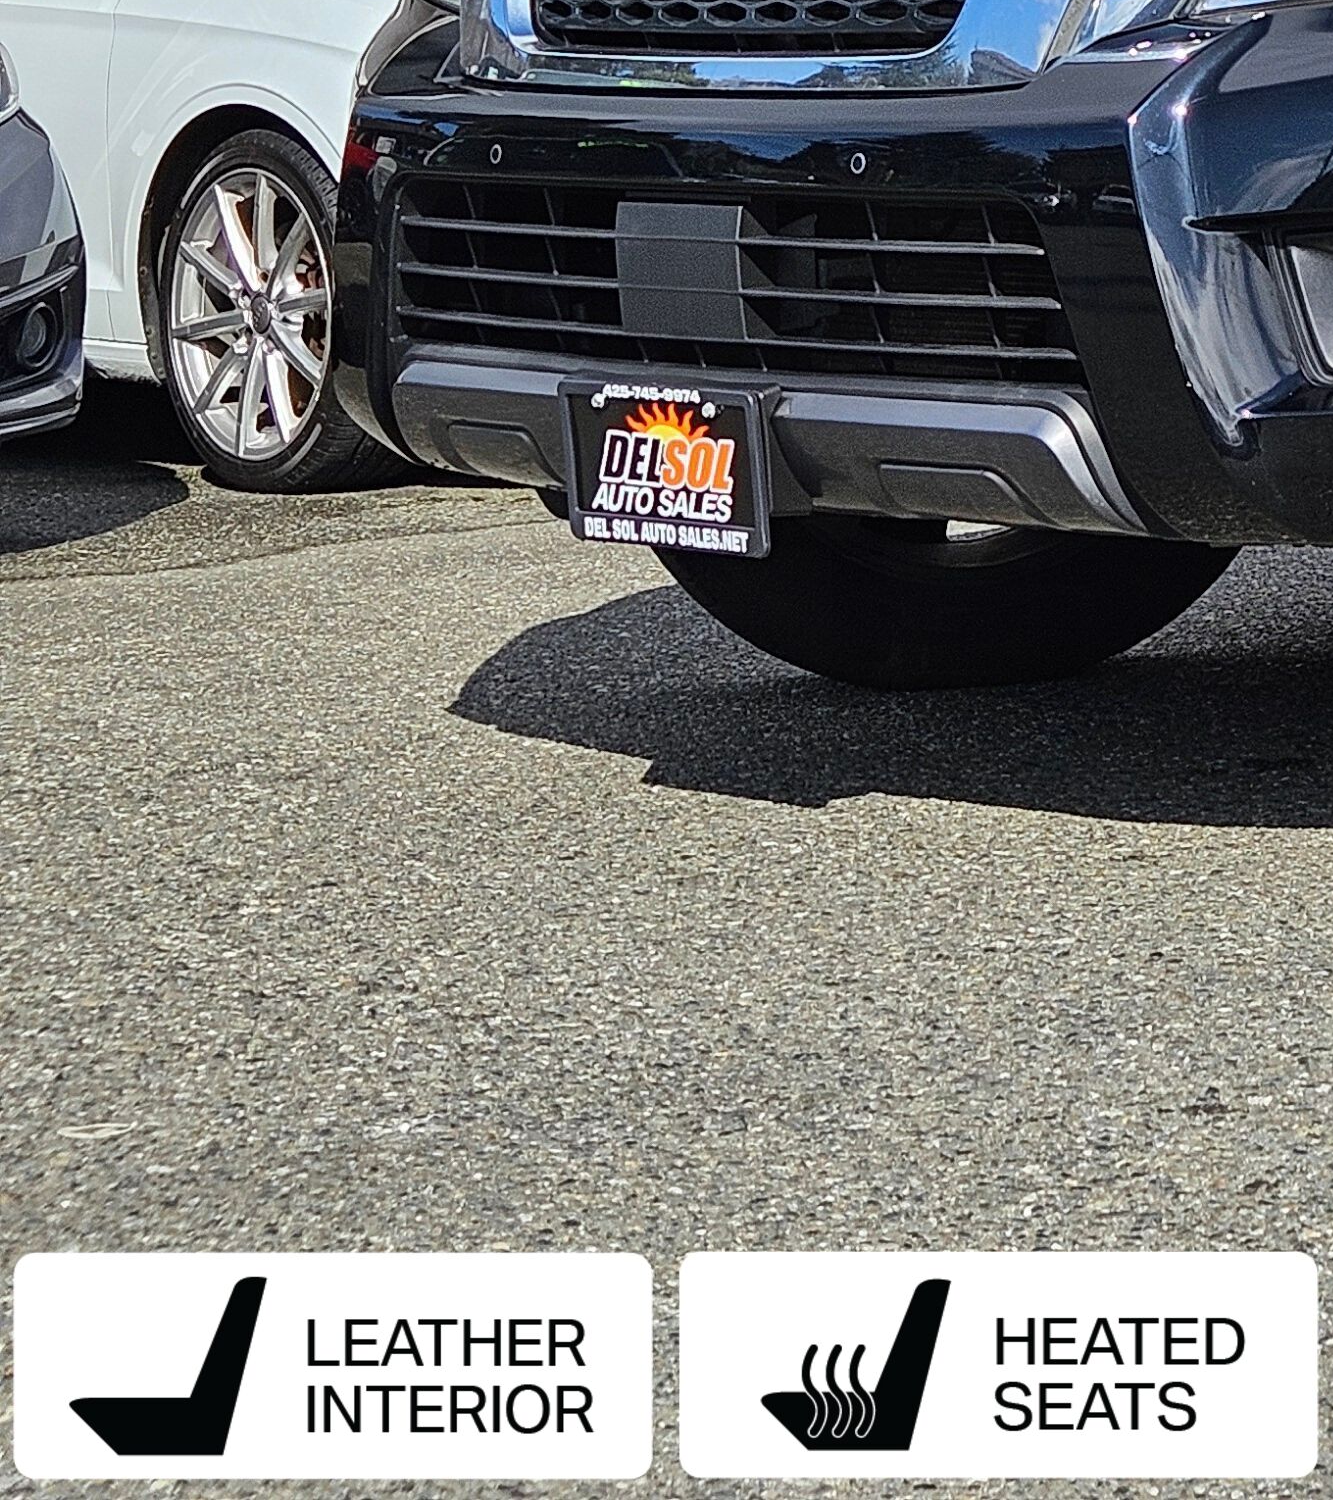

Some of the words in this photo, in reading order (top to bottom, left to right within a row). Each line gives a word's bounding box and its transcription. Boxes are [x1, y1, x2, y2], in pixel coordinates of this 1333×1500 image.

[602, 383, 701, 404] 425-745-9974
[599, 429, 735, 494] DELSOL
[591, 485, 654, 515] AUTO
[657, 489, 733, 523] SALES
[584, 516, 611, 539] DEL
[612, 520, 639, 541] SOL
[641, 522, 676, 545] AUTO
[678, 525, 749, 553] SALES.NET
